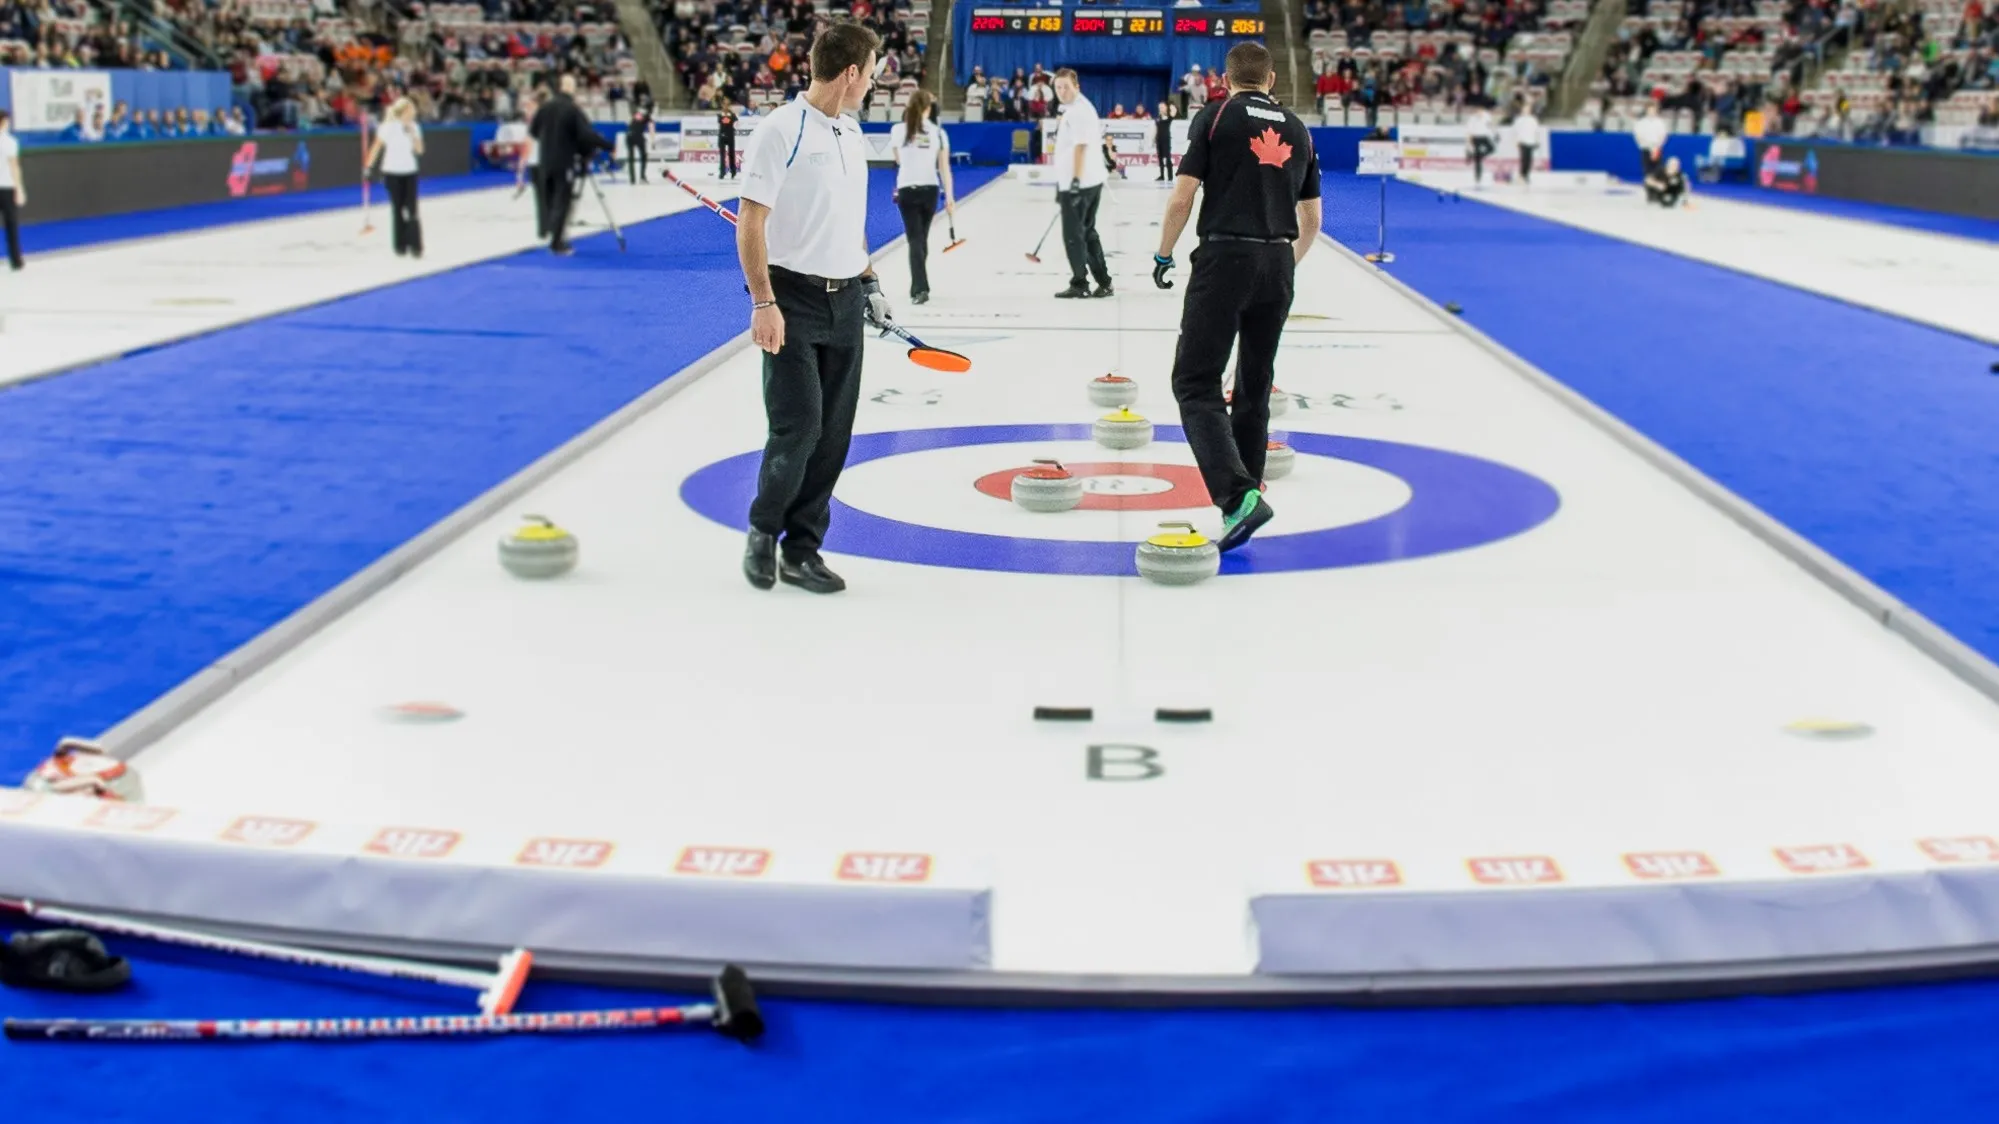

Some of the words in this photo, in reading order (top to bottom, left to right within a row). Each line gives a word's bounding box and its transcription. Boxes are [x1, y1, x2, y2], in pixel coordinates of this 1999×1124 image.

[1012, 19, 1022, 29] C
[1215, 19, 1225, 29] A
[1086, 744, 1165, 782] B
